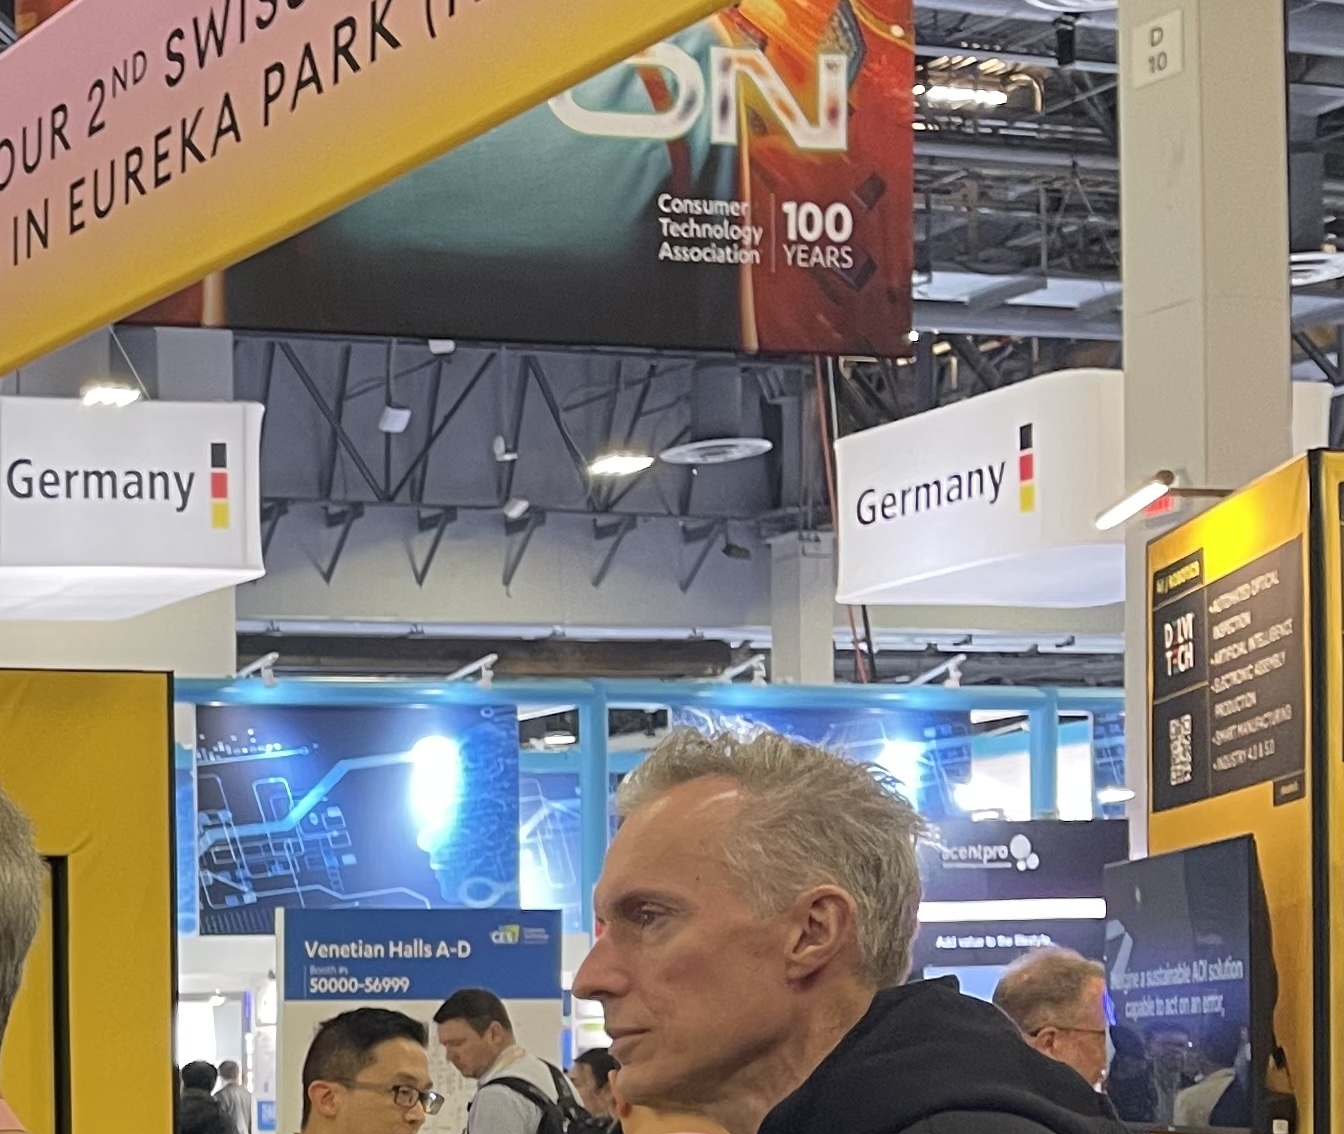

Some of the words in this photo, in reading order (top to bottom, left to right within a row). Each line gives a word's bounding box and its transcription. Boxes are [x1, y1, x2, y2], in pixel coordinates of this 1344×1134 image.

[1150, 26, 1164, 48] D
[87, 50, 148, 138] 2ND
[164, 0, 309, 88] SWIS
[1148, 51, 1168, 74] 10
[13, 197, 50, 267] IN
[68, 92, 242, 236] EUREKA
[262, 0, 402, 128] PARK
[657, 193, 750, 217] Consumer
[657, 217, 763, 245] Technology
[781, 200, 854, 243] 100
[658, 241, 761, 264] Association
[782, 244, 854, 269] YEARS
[6, 458, 195, 512] Germany
[855, 458, 1007, 526] Germany
[304, 940, 385, 959] Venetian
[389, 938, 433, 959] Halls
[436, 940, 472, 959] A-D
[1208, 955, 1244, 982] solution
[309, 976, 410, 993] 50000-56999
